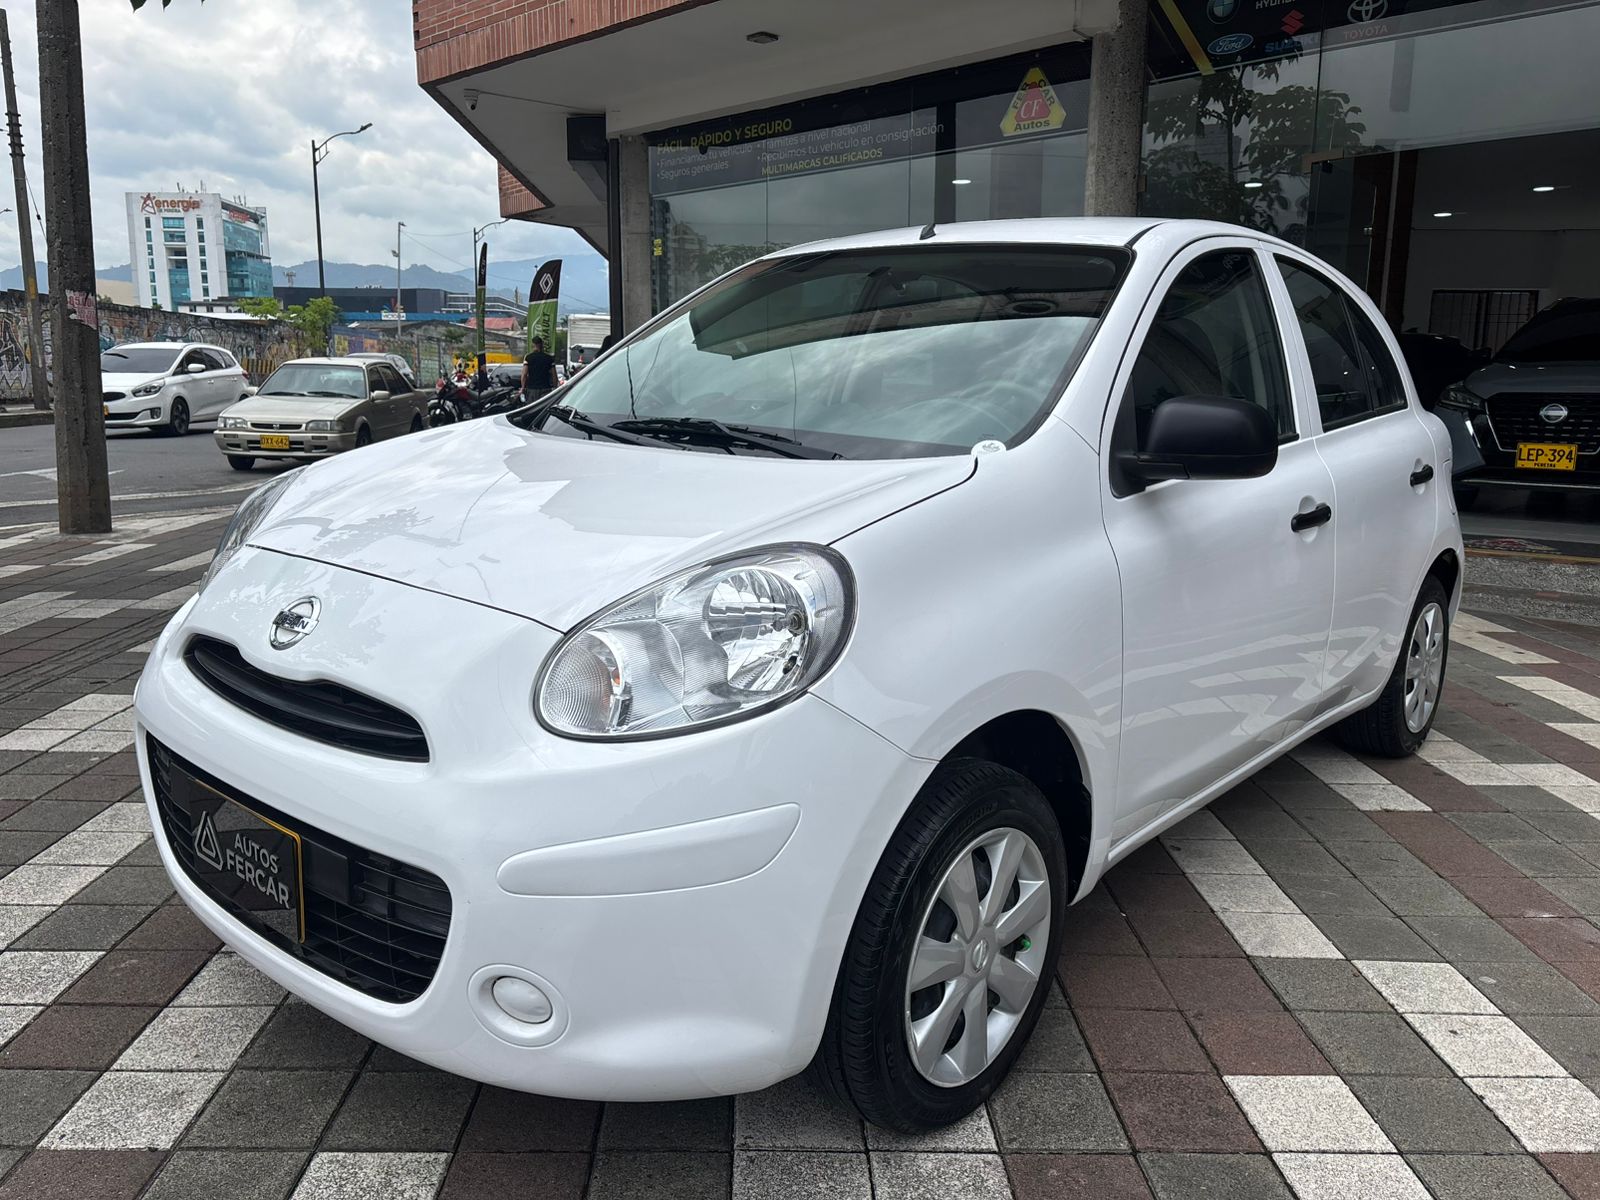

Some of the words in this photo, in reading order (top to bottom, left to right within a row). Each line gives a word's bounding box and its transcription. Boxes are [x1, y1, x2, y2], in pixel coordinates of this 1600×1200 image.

[1343, 24, 1389, 41] TOYOTA
[735, 128, 742, 140] Y
[744, 118, 793, 138] SEGURO
[808, 128, 828, 142] nivel
[831, 122, 871, 138] nacional
[1014, 119, 1050, 132] Autos
[808, 143, 818, 155] tu
[861, 136, 874, 146] en
[876, 122, 944, 144] consignación
[691, 160, 729, 176] generales
[761, 156, 821, 175] MULTIMARCAS
[823, 147, 883, 166] CALIFICADOS
[543, 313, 552, 353] RENAULT
[234, 833, 278, 874] AUTOS
[226, 848, 290, 909] FERCAR
